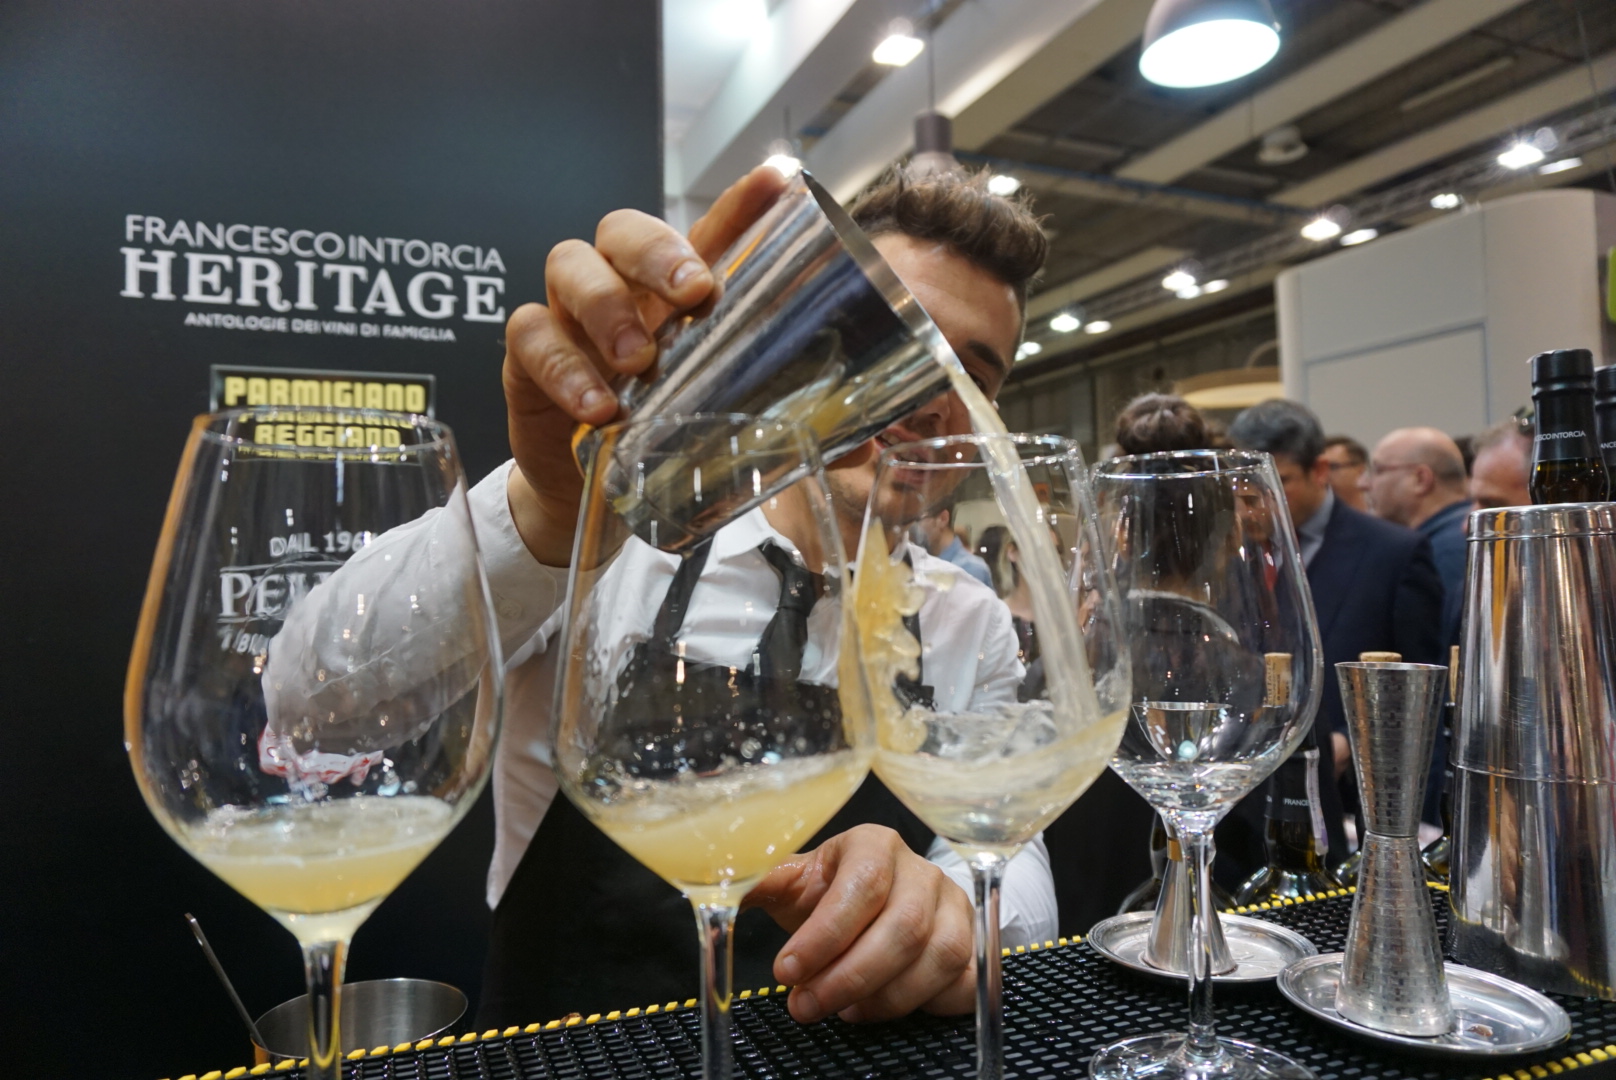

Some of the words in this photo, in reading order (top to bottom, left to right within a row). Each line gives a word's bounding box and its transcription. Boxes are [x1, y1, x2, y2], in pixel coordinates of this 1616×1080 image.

[125, 214, 345, 259] FRANCESCO
[348, 235, 507, 274] INTORCIA
[120, 247, 506, 324] HERITAGE
[184, 312, 289, 333] ANTOLOGIE
[291, 318, 321, 334] DEI
[322, 320, 358, 336] VINI
[360, 322, 380, 338] DI
[382, 323, 457, 342] FAMIGLIA
[224, 376, 425, 412] PARMIGIANO
[253, 424, 402, 449] REGGIANO
[1552, 430, 1586, 440] INTORCIA
